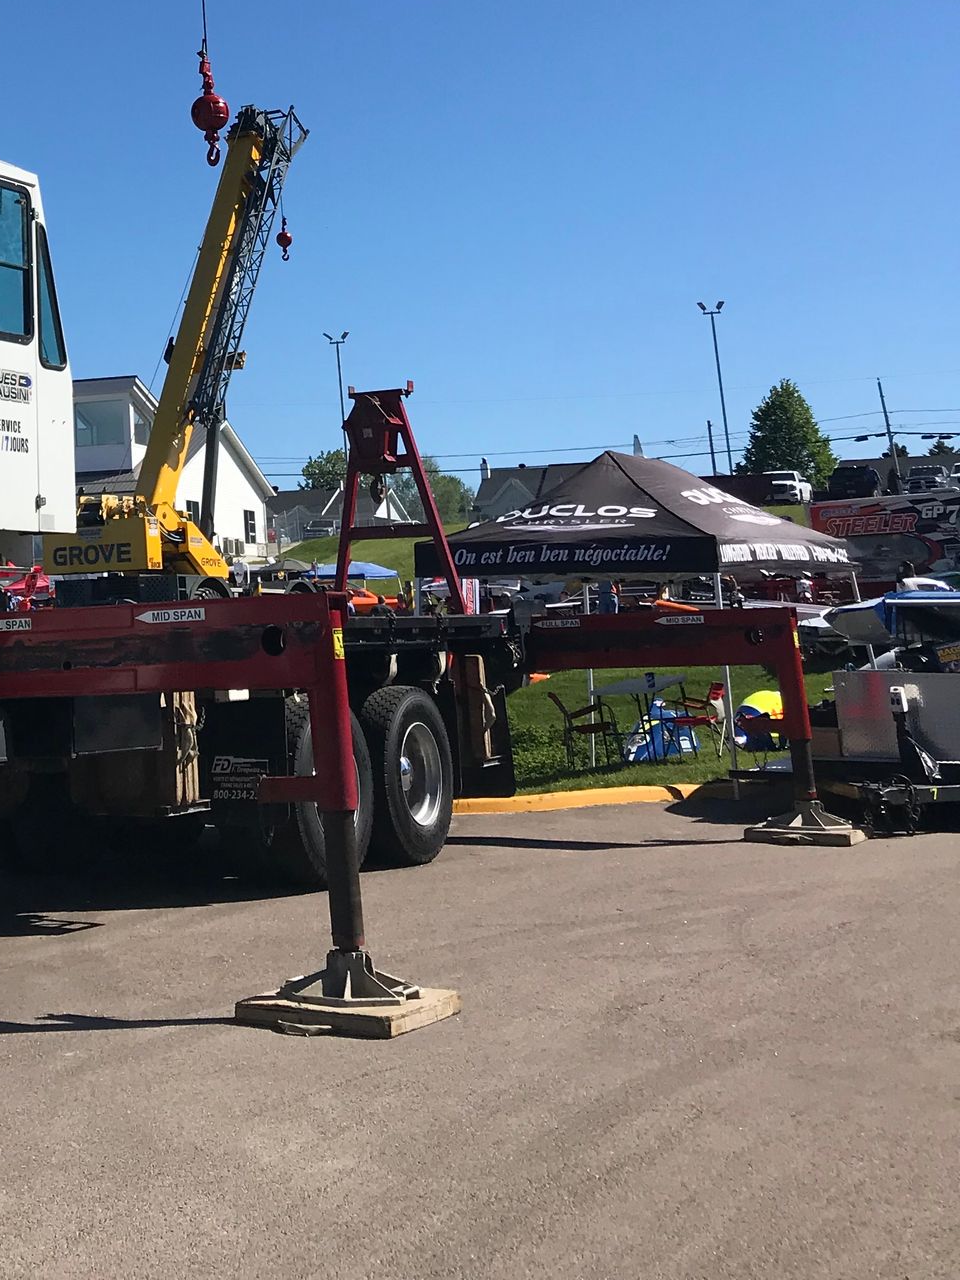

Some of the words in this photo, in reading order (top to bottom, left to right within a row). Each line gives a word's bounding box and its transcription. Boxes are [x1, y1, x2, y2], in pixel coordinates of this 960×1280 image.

[496, 504, 658, 523] DUCLOS
[825, 513, 918, 537] STEELER
[53, 543, 132, 567] GROVE
[455, 548, 476, 565] On
[480, 549, 503, 564] est
[506, 546, 535, 563] ben
[540, 544, 569, 562] ben
[573, 544, 671, 566] négociable!
[201, 557, 221, 568] GROVE
[152, 611, 170, 622] MID
[173, 610, 201, 621] SPAN
[5, 619, 31, 629] SPAN
[560, 619, 580, 627] SPAN
[213, 789, 258, 800] 800-234-2
